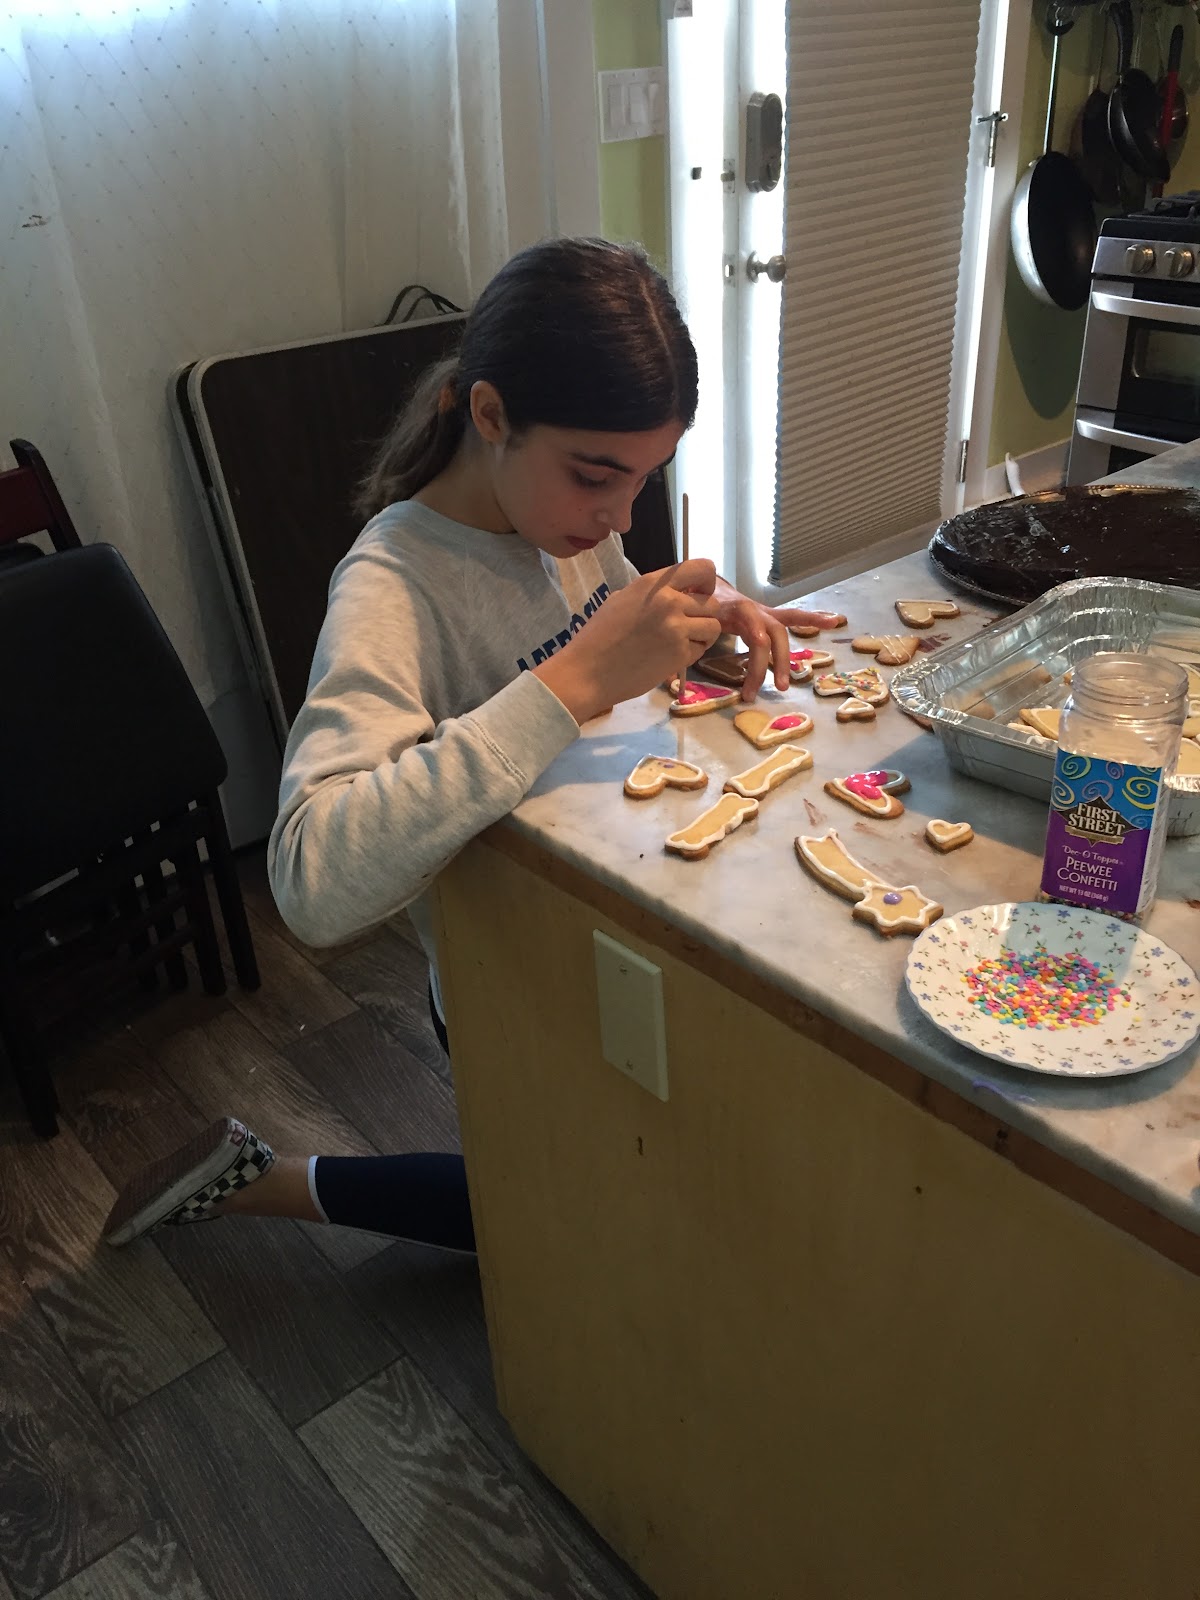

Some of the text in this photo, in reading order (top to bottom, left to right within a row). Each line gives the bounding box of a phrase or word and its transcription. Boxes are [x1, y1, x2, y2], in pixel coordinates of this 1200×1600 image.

[1077, 802, 1120, 822] FIRST
[1068, 813, 1125, 835] STREET
[1066, 856, 1113, 877] PEEWEE
[1057, 867, 1118, 891] CONFETTI
